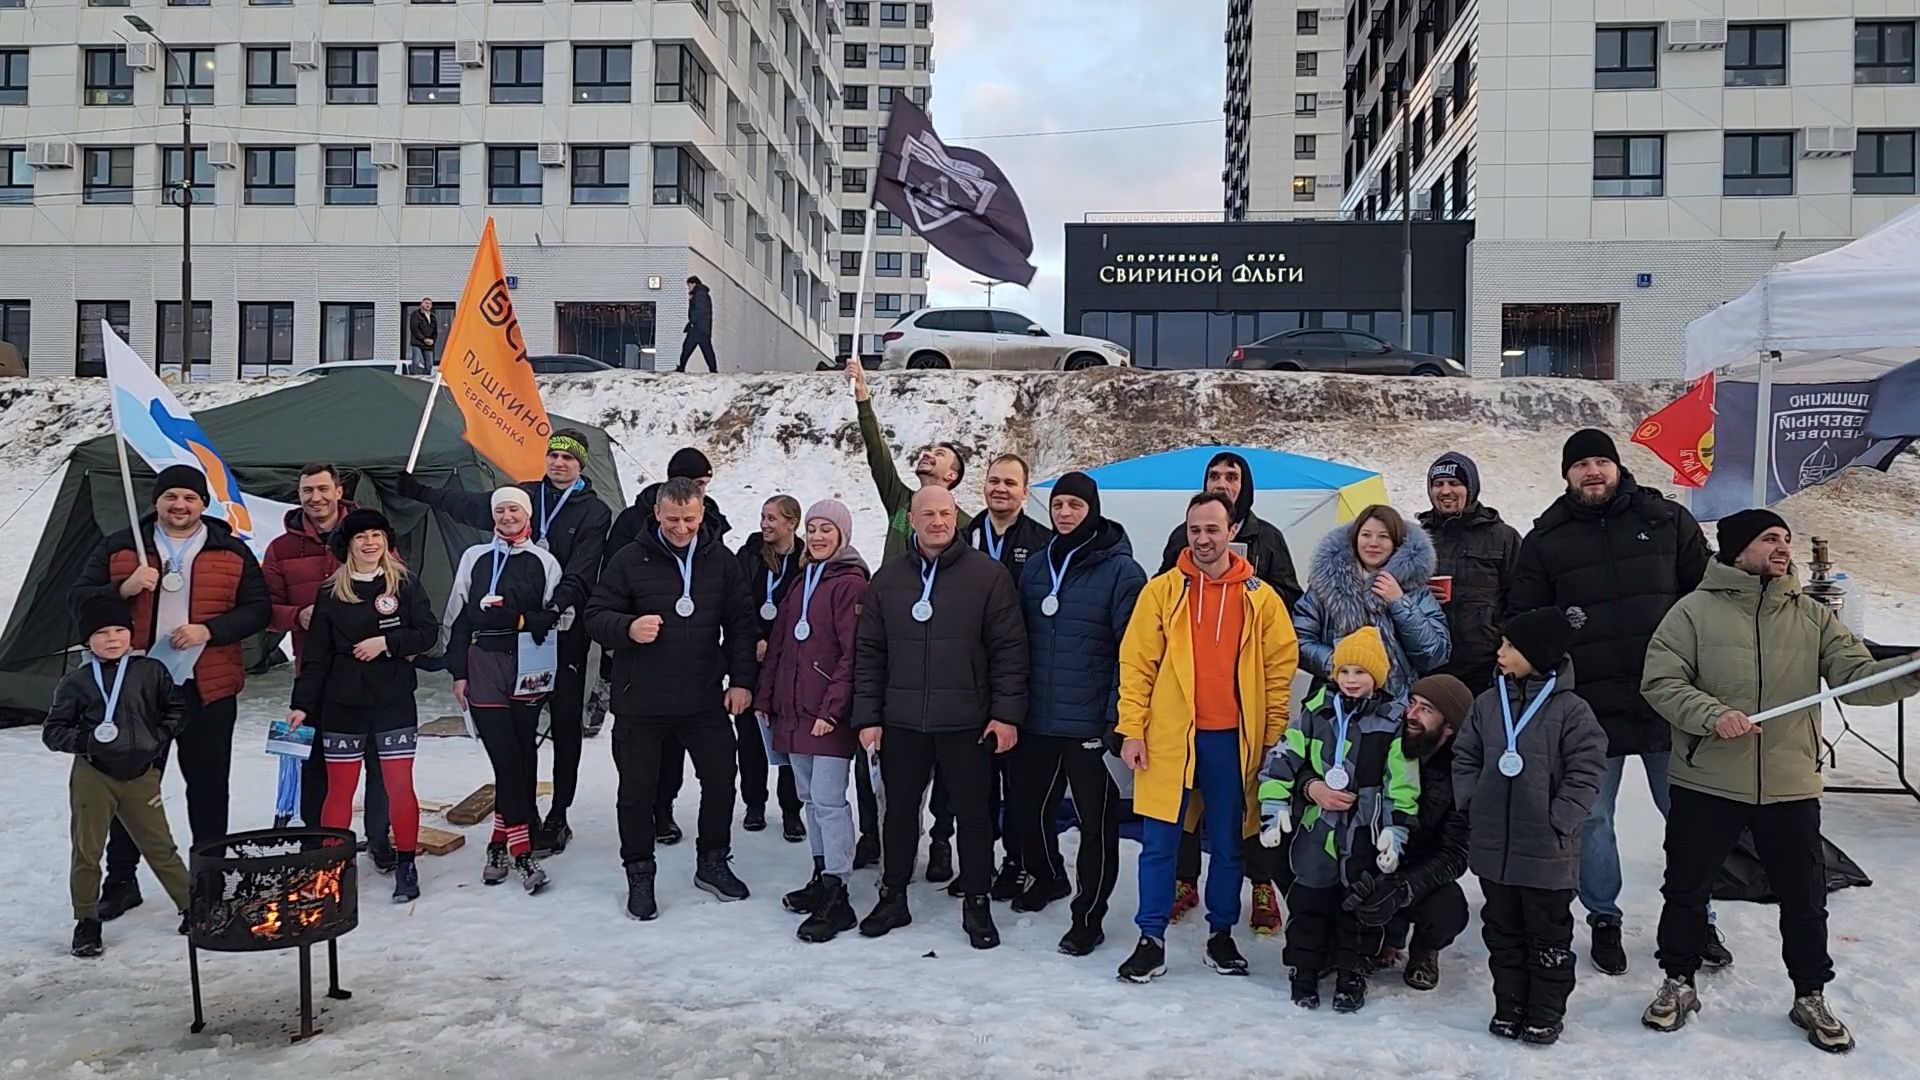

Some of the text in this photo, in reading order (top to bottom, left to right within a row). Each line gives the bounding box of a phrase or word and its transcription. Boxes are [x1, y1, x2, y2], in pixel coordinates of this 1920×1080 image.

[1099, 265, 1223, 283] СВИРИНОЙ
[1116, 253, 1286, 262] СПОРТИВНЫЙ КЛУБ
[463, 349, 550, 437] ПУШКИНО
[463, 381, 525, 446] ЕРЕБРЯНКА
